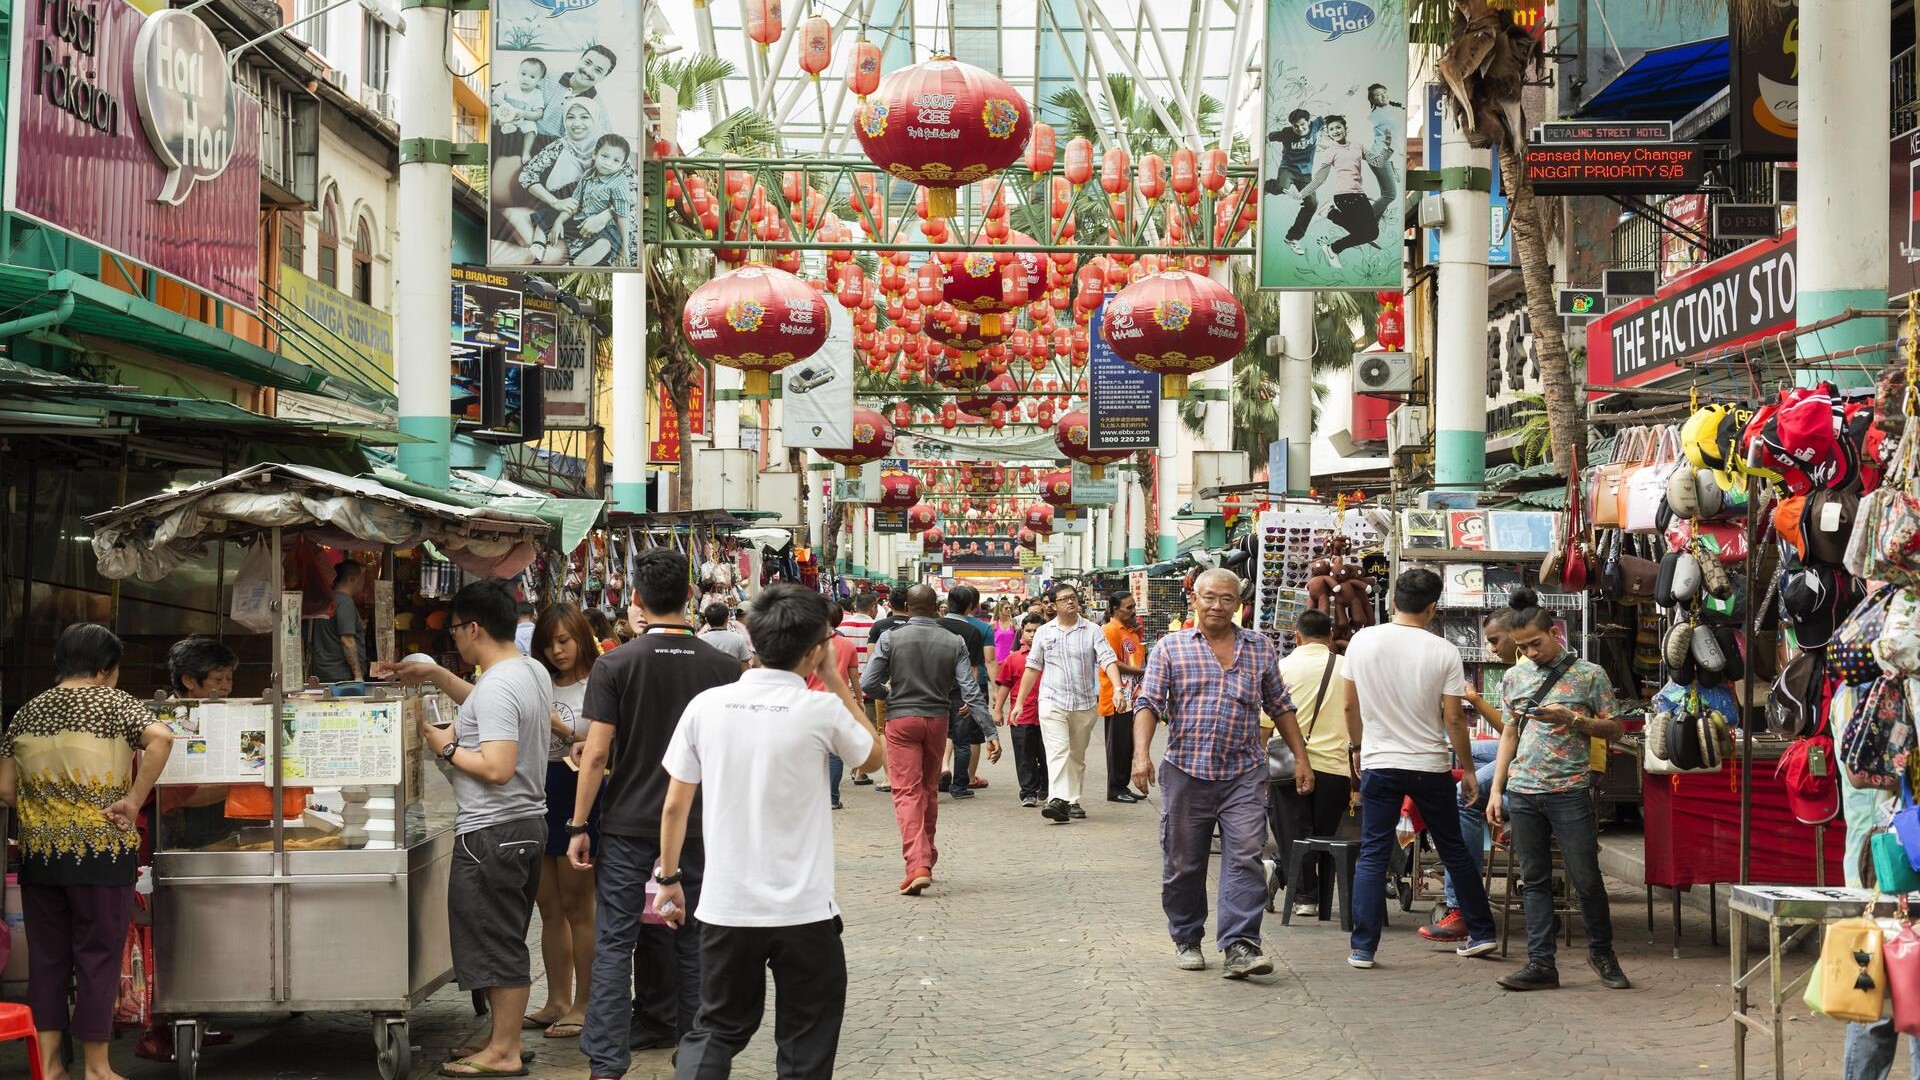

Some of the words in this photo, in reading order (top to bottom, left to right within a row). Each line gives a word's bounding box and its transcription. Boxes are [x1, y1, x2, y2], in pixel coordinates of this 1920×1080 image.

[1312, 2, 1348, 19] Hari
[1513, 8, 1537, 26] nt
[1331, 14, 1369, 31] Hari
[157, 20, 204, 98] Hari
[34, 39, 119, 138] Pakaian
[917, 108, 951, 125] KEE
[182, 100, 227, 171] Hari
[1547, 128, 1592, 138] PETALING
[1596, 128, 1631, 138] STREET
[1636, 127, 1666, 138] HOTEL
[1527, 149, 1581, 162] icensed
[1584, 149, 1631, 164] Money
[1634, 148, 1692, 164] Changer
[1529, 165, 1581, 179] INGGIT
[1584, 165, 1655, 179] PRIORITY
[1659, 165, 1684, 179] S/B
[1722, 216, 1769, 228] OPEN
[1488, 254, 1506, 262] mpur
[452, 269, 464, 279] OR
[466, 270, 508, 287] BRANCHES
[524, 297, 552, 309] ANCHES
[1612, 316, 1647, 375] THE
[1651, 273, 1740, 362] FACTORY
[1748, 252, 1796, 326] STO
